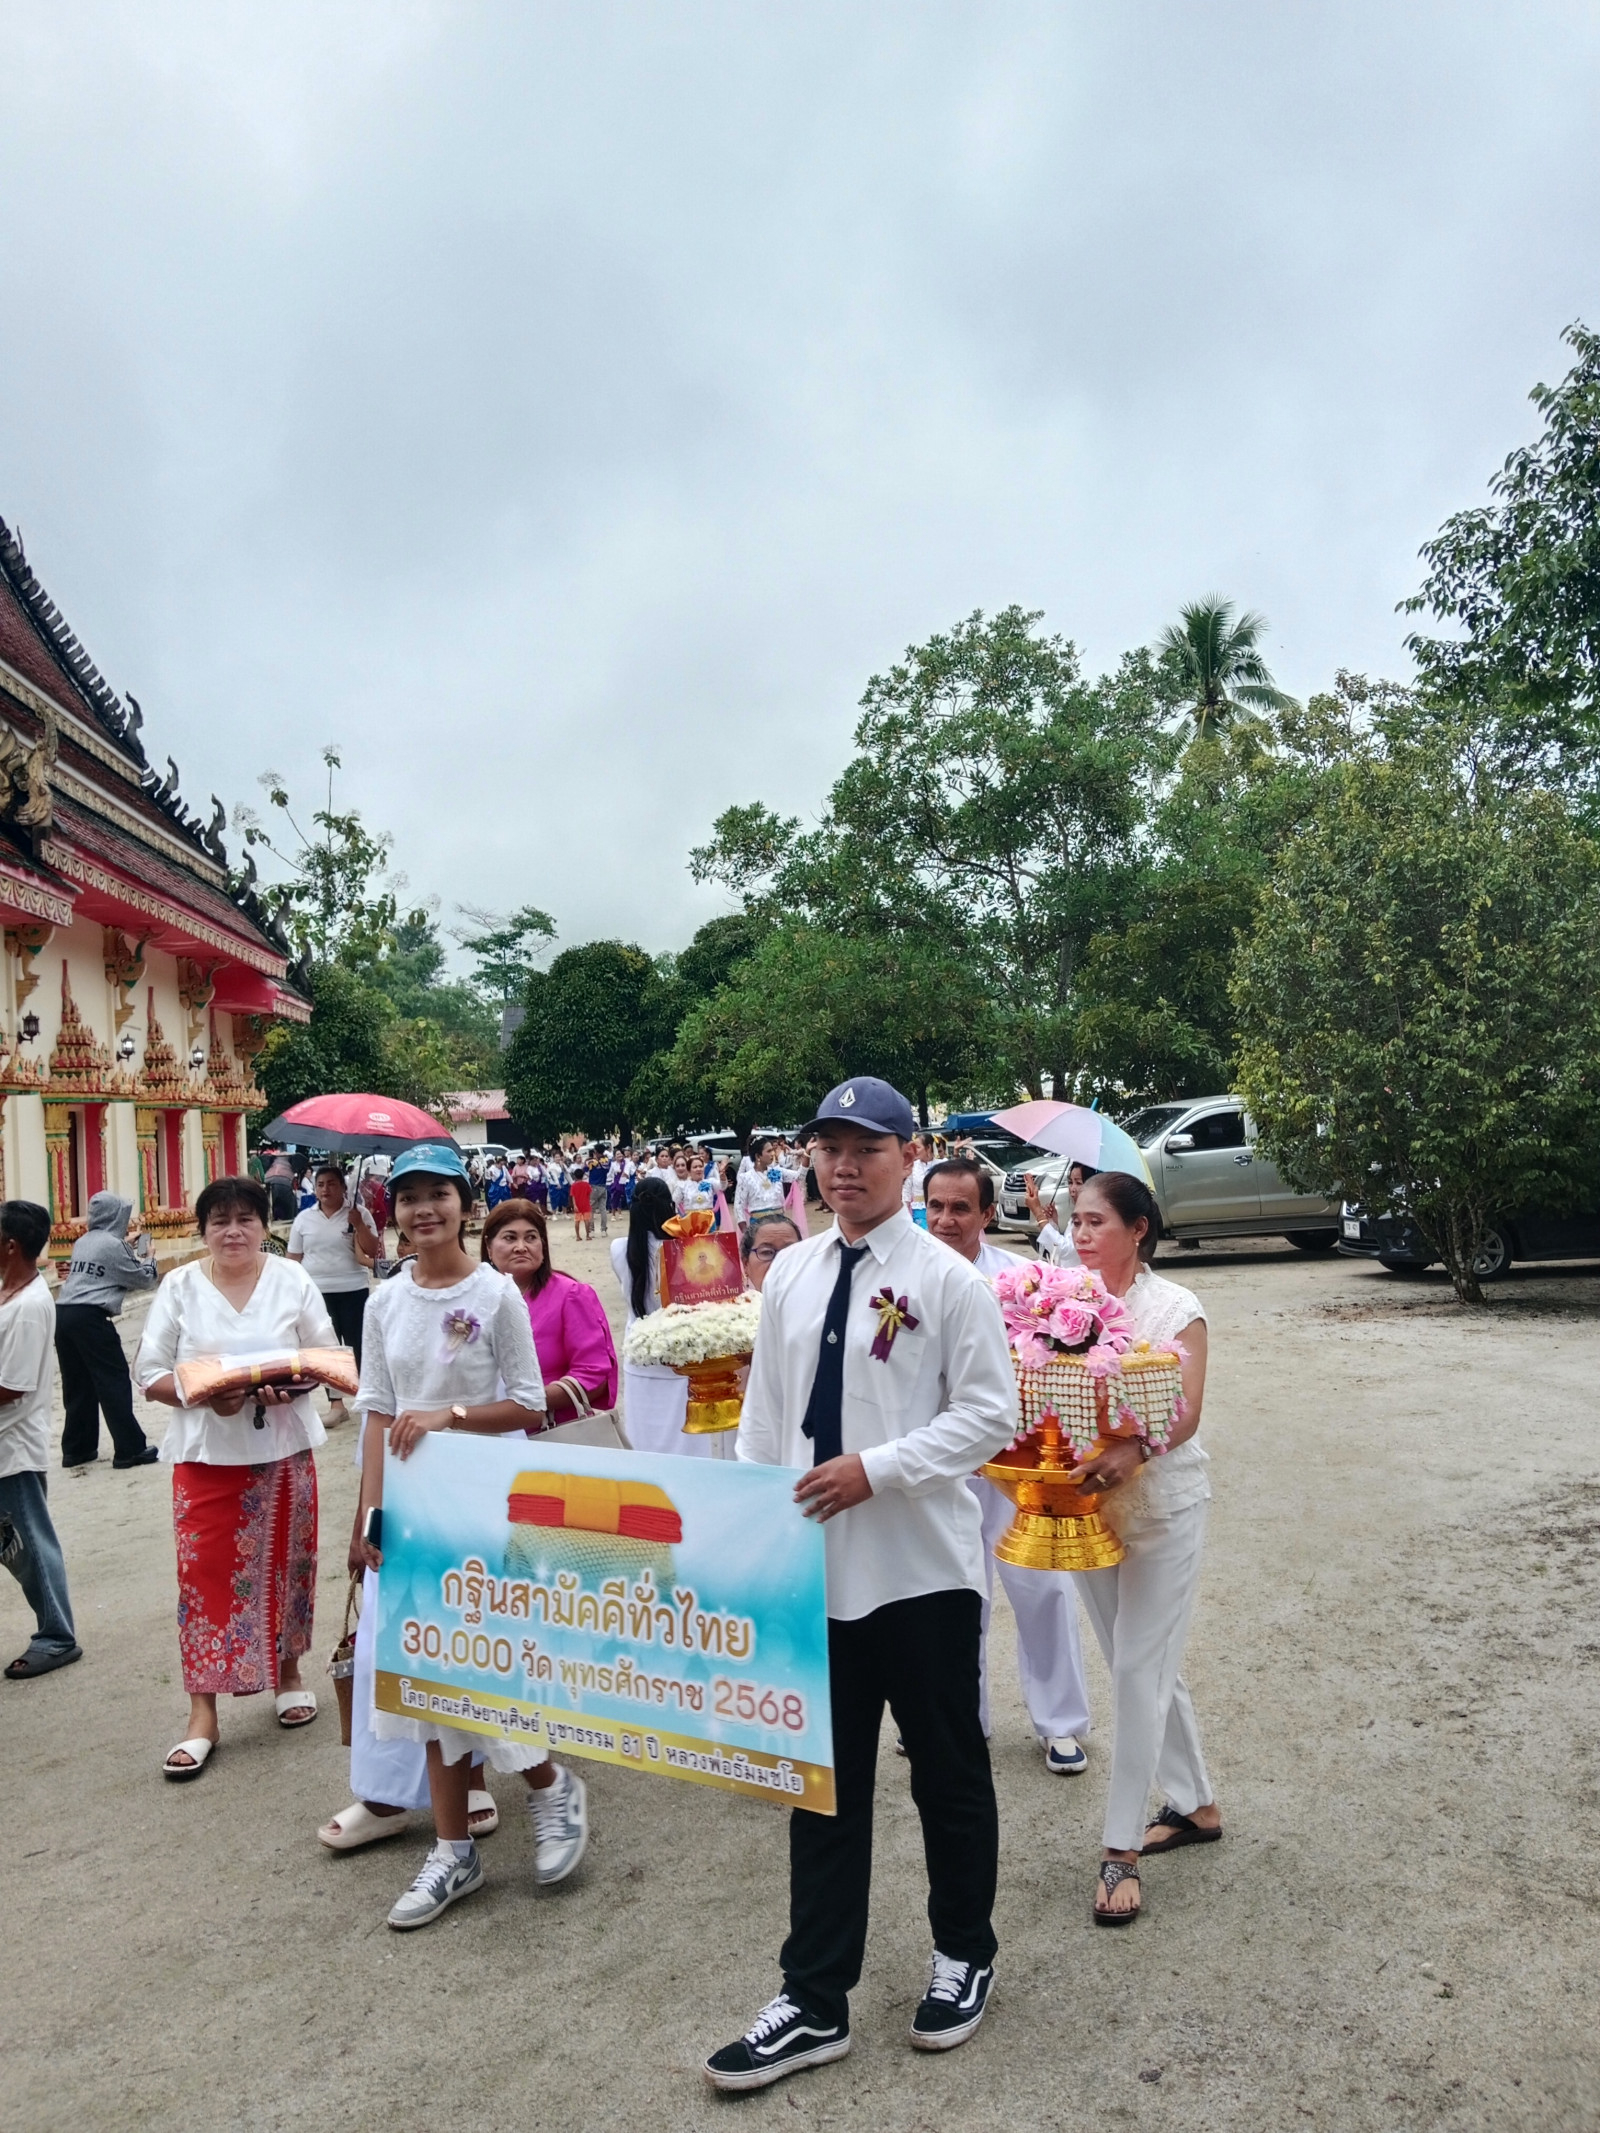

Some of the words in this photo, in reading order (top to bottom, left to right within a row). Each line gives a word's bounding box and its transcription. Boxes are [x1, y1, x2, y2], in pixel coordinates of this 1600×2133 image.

[444, 1560, 750, 1657] กฐินสามัคคีทั่วไทย
[404, 1621, 512, 1673] 30,000
[521, 1639, 552, 1681] วัด
[559, 1658, 703, 1711] พุทธศักราช
[714, 1679, 804, 1731] 2568
[401, 1681, 426, 1707] โดย
[431, 1697, 541, 1734] คณะศิษยานุศิษย์
[546, 1721, 615, 1750] บูชาธรรม
[622, 1735, 641, 1758] 81
[647, 1736, 659, 1759] ปี
[667, 1747, 802, 1792] หลวงพ่อธัมมชโย
